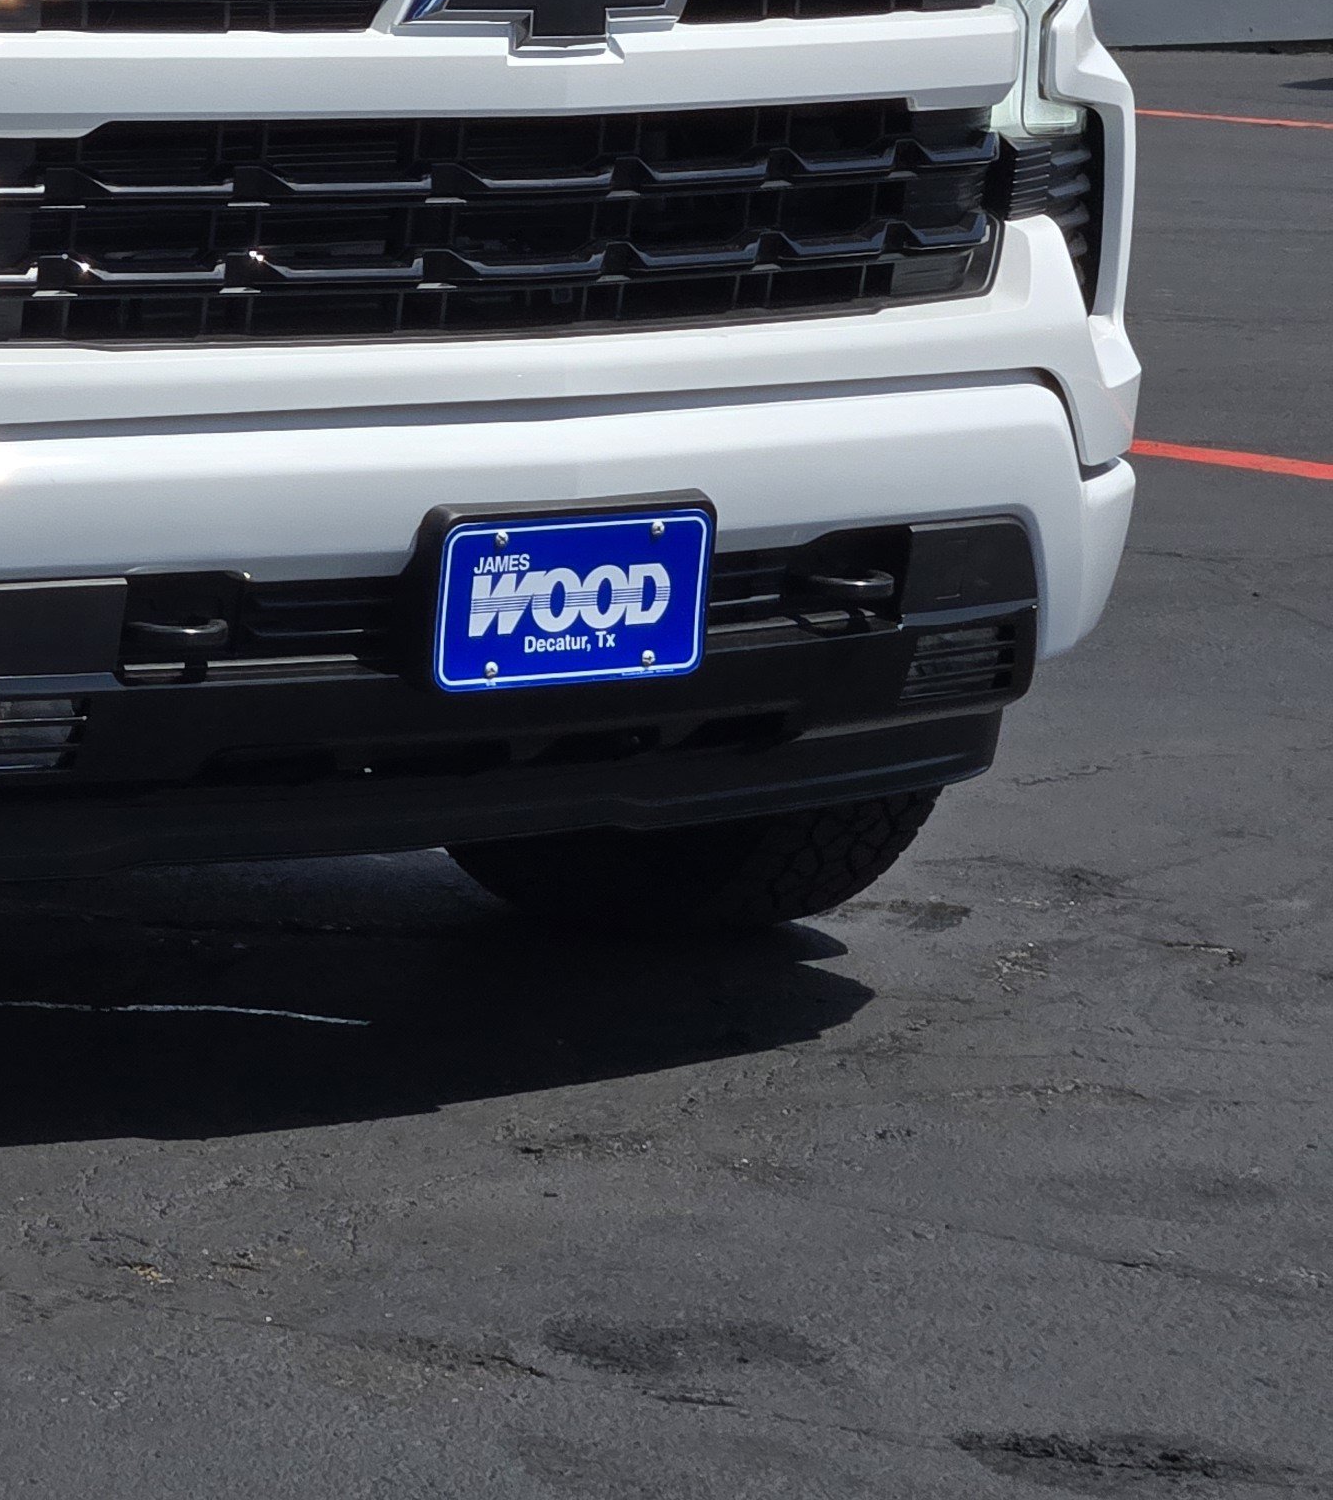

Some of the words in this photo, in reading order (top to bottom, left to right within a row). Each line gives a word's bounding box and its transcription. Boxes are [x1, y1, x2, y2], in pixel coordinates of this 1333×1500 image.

[473, 553, 531, 575] JAMES
[467, 562, 672, 638] WOOD
[523, 634, 592, 655] Decatur,
[595, 630, 616, 649] Tx
